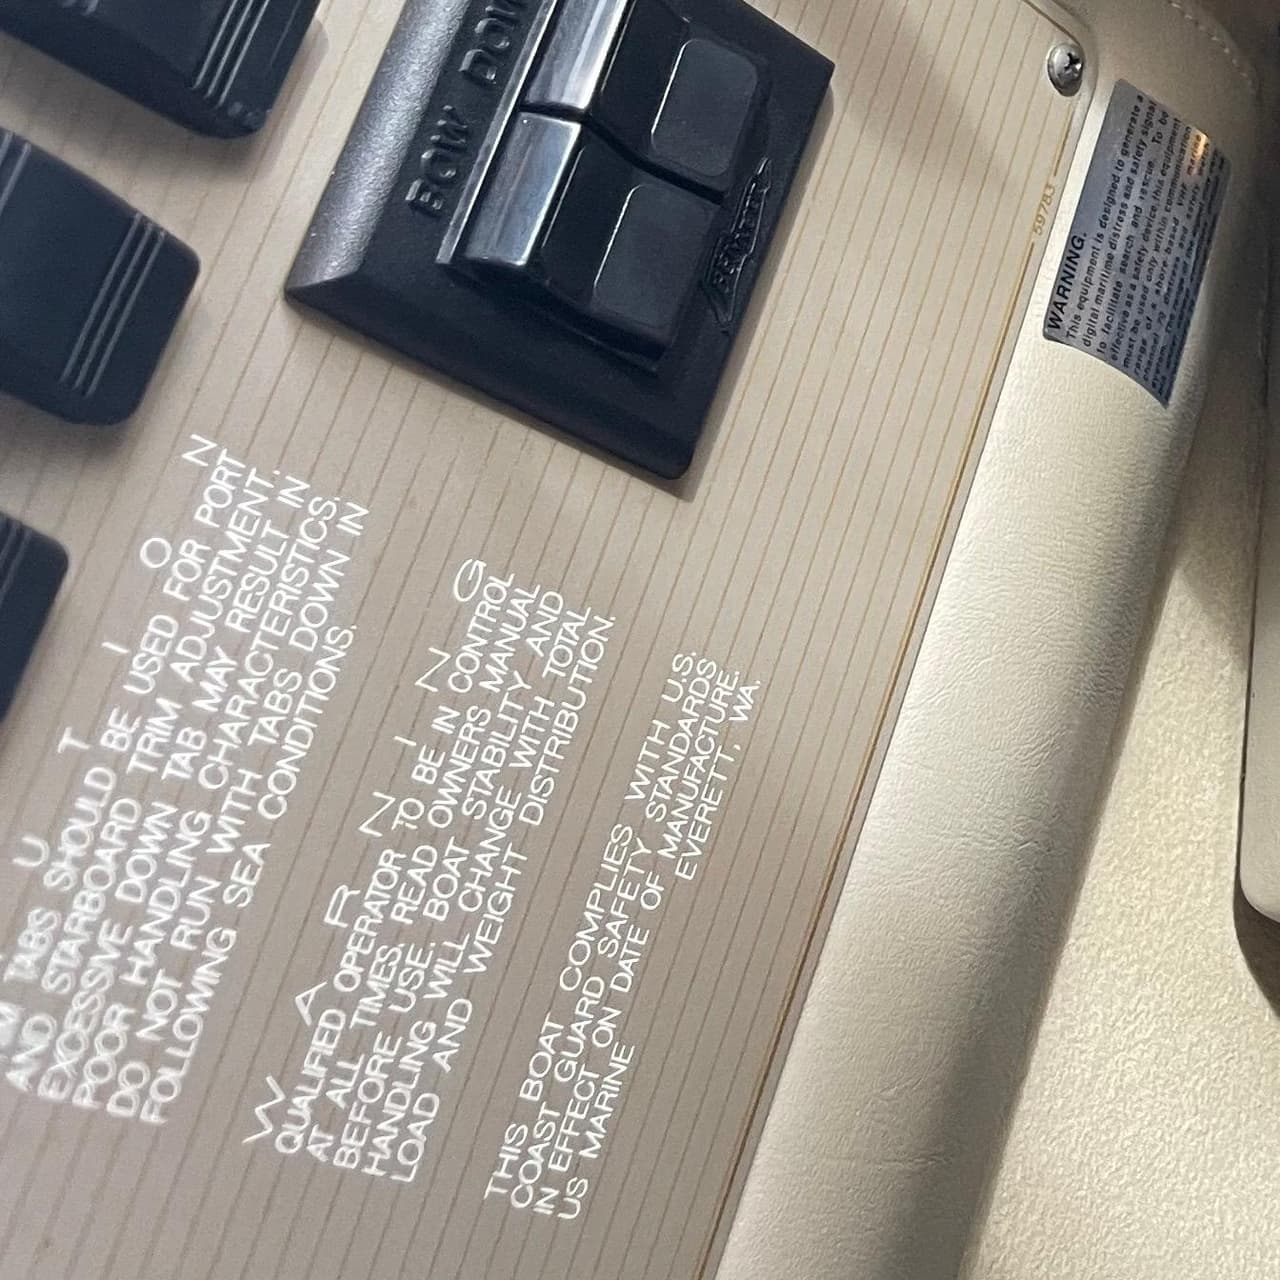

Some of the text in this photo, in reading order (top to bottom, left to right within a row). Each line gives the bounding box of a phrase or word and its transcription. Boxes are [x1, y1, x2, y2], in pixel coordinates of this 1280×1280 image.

[405, 105, 468, 214] BOW
[1048, 232, 1087, 330] WARNING.
[1066, 313, 1081, 339] This
[1078, 246, 1100, 311] equipment
[1094, 233, 1104, 244] is
[1100, 174, 1121, 229] designed
[1115, 159, 1125, 172] to
[1120, 105, 1141, 158] generate
[1082, 100, 1157, 347] digital maritime distress and safety signal
[1096, 341, 1107, 355] to
[1102, 280, 1123, 336] facilitate
[1120, 234, 1135, 274] search
[1132, 204, 1143, 228] and
[1152, 131, 1163, 145] To
[1162, 111, 1169, 126] be
[1111, 310, 1130, 361] effective
[1126, 294, 1135, 308] as
[1133, 245, 1148, 281] safety
[1153, 179, 1165, 204] this
[1161, 117, 1182, 177] equipment
[1123, 337, 1137, 368] must
[1138, 286, 1149, 315] used
[1146, 256, 1159, 282] only
[1153, 217, 1168, 254] within
[1165, 126, 1191, 213] communication
[4, 907, 62, 980] TABS
[44, 766, 116, 891] SHOULD
[100, 706, 141, 752] BE
[123, 614, 178, 694] USED
[163, 539, 211, 601] FOR
[193, 448, 246, 528] PORT
[6, 468, 281, 1091] AND STARBOARD TRIM ADJUSTMENT.
[37, 476, 310, 1101] EXCESSIVE DOWN TAB MAY RESULT IN
[72, 496, 340, 1108] POOR HANDLING CHARACTERISTICS.
[106, 502, 369, 1117] DO NOT RUN WITH TABS DOWN IN
[140, 625, 357, 1124] FOLLOWING SEA CONDITIONS.
[275, 573, 515, 1153] QUALIFIED OPERATOR TO BE IN CONTROL
[307, 584, 540, 1161] AT ALL TIMES. READ OWNERS MANUAL
[333, 590, 564, 1169] BEFORE USE. BOAT STABILITY AND
[361, 606, 591, 1176] HANDLING WILL CHANGE WITH TOTAL
[390, 615, 616, 1183] LOAD AND WEIGHT DISTRIBUTION.
[484, 651, 697, 1200] THIS BOAT COMPLIES WITH U.S.
[510, 658, 718, 1208] COAST GUARD SAFETY STANDARDS
[533, 669, 740, 1216] IN EFFECT ON DATE OF MANUFACTURE.
[557, 1176, 589, 1220] US
[579, 1041, 635, 1159] MARINE
[729, 679, 762, 722] WA.
